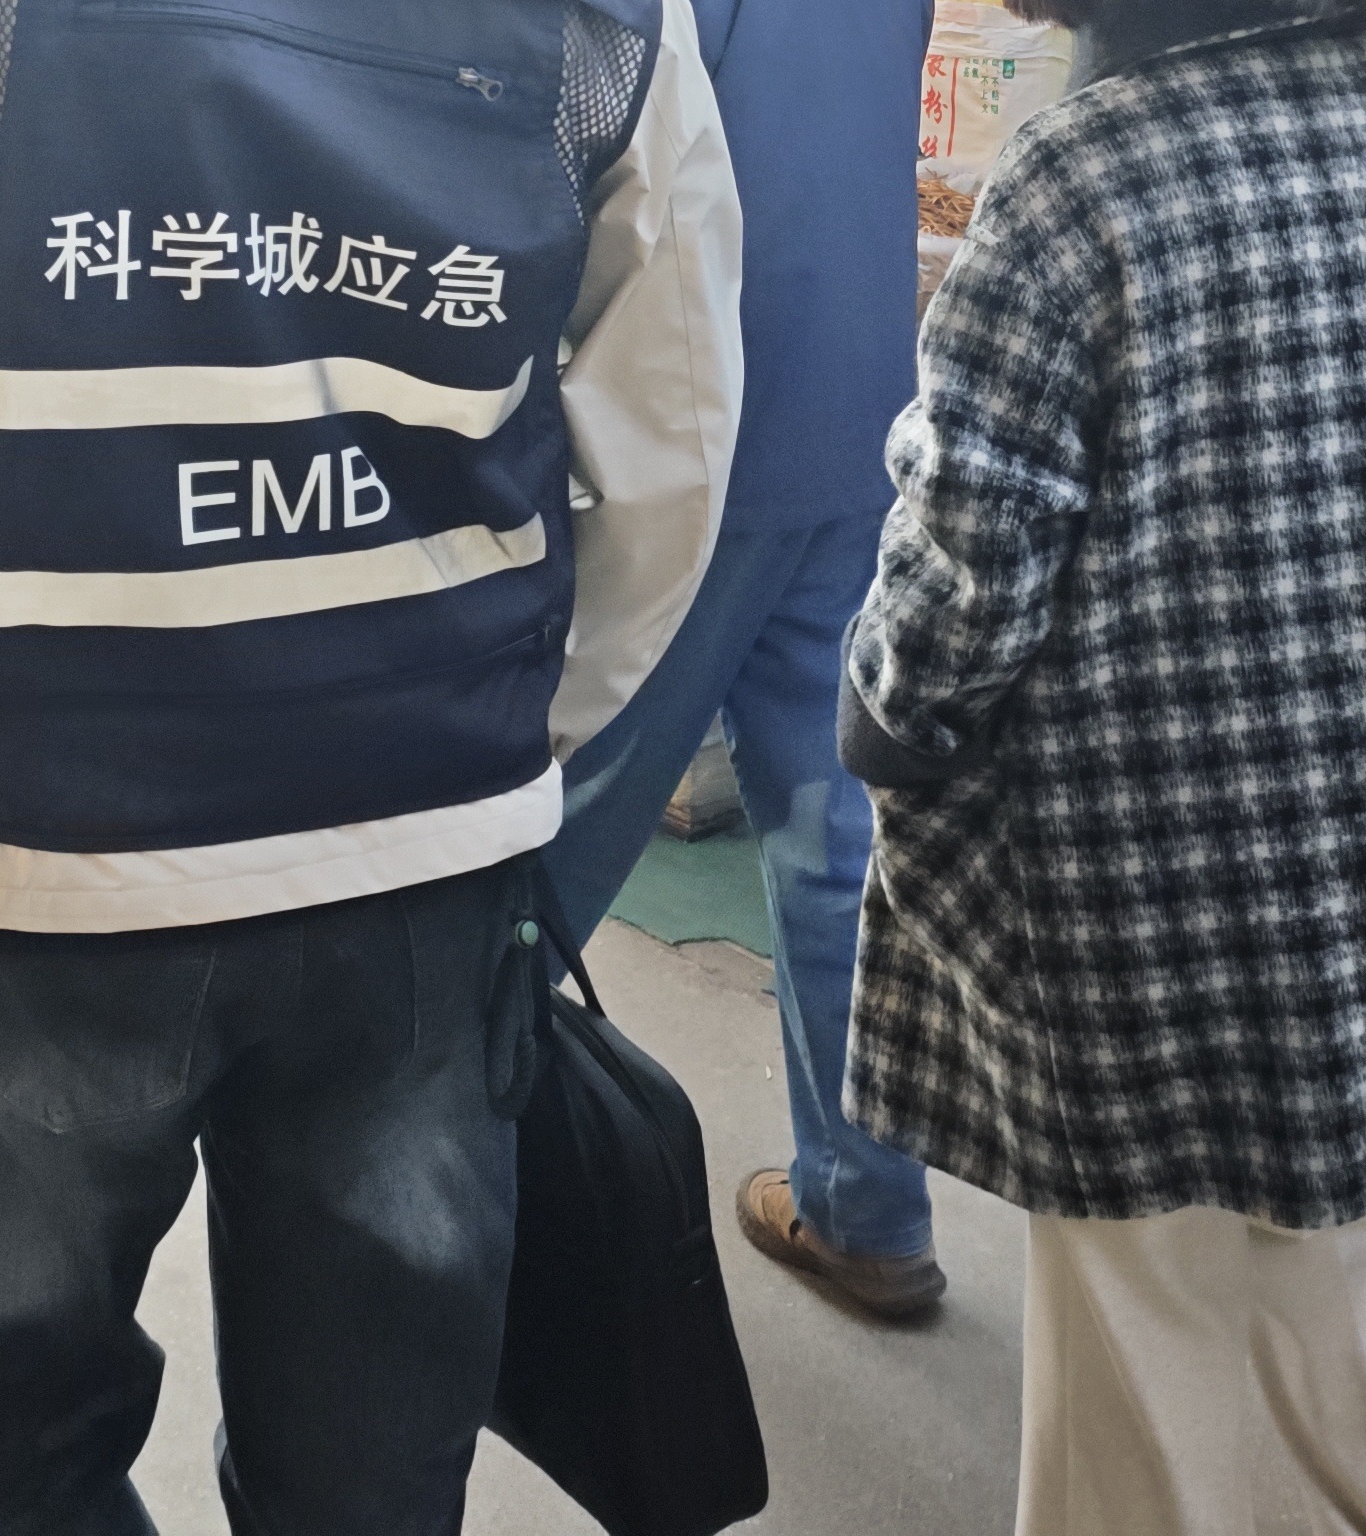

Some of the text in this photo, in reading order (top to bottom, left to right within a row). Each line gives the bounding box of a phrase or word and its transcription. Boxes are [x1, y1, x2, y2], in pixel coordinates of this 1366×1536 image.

[44, 209, 508, 328] 科学城应急
[178, 446, 390, 546] EMB
